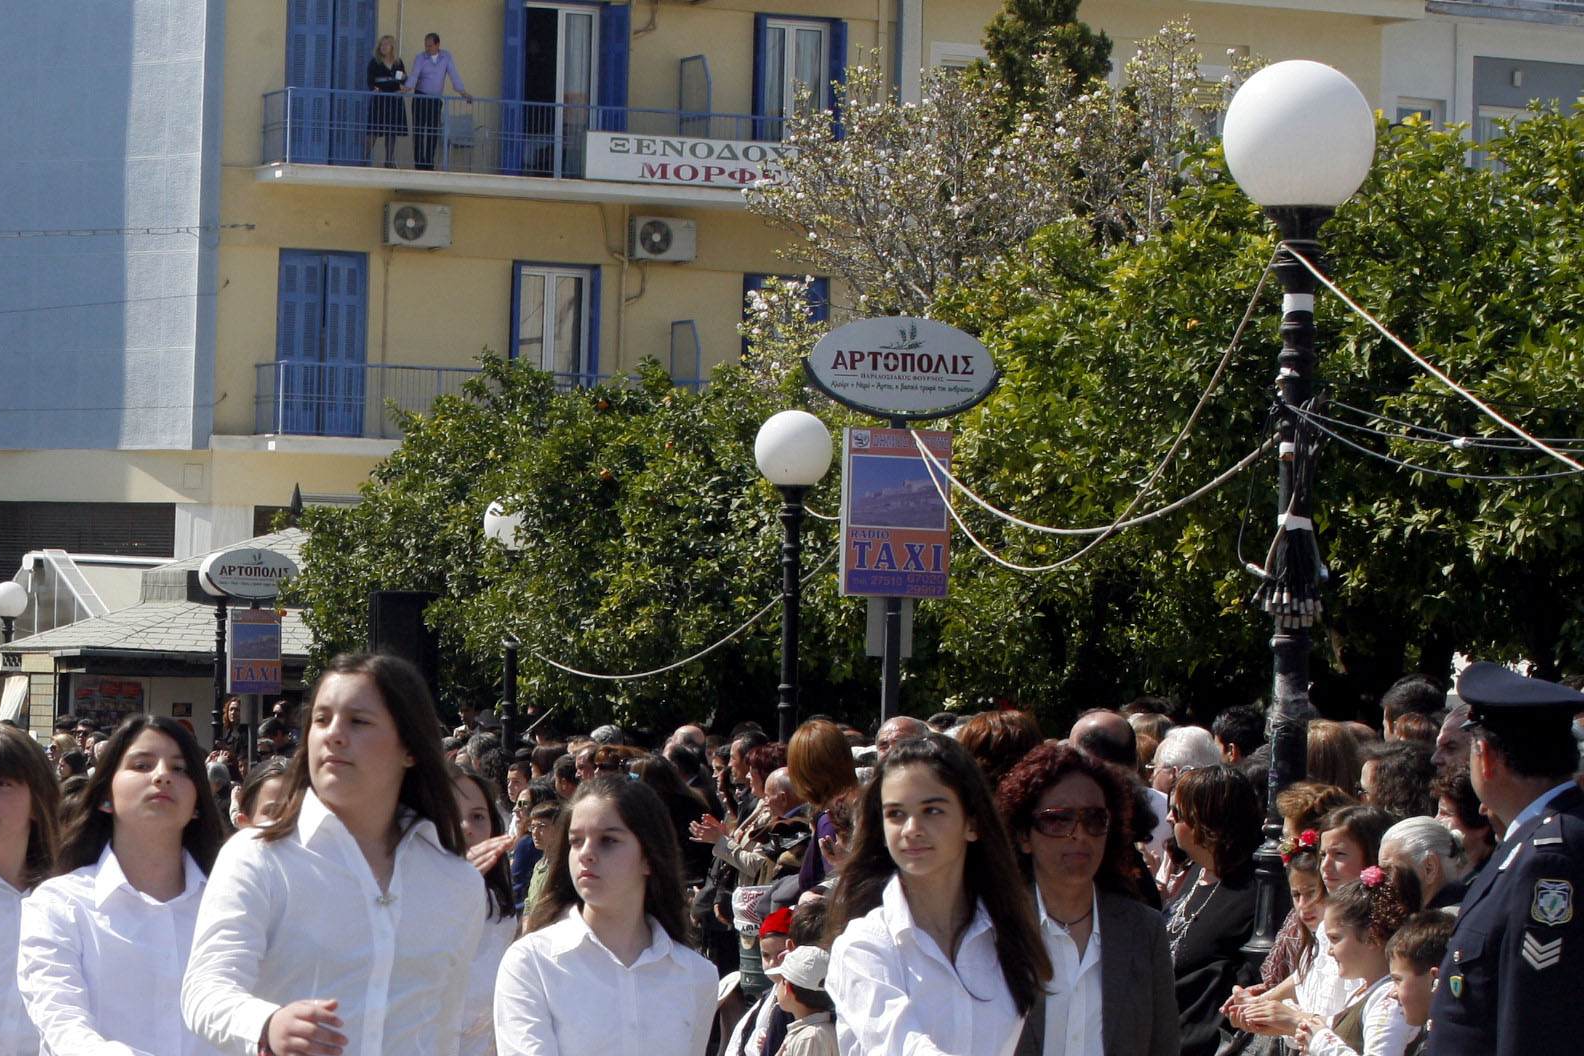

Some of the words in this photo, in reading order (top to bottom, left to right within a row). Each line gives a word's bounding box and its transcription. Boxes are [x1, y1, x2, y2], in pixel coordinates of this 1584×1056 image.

[831, 350, 974, 376] ΑΡΤΟΠΟΛΙΣ
[851, 529, 890, 539] RADIO
[852, 540, 944, 572] TAXI
[234, 666, 281, 681] TAXI
